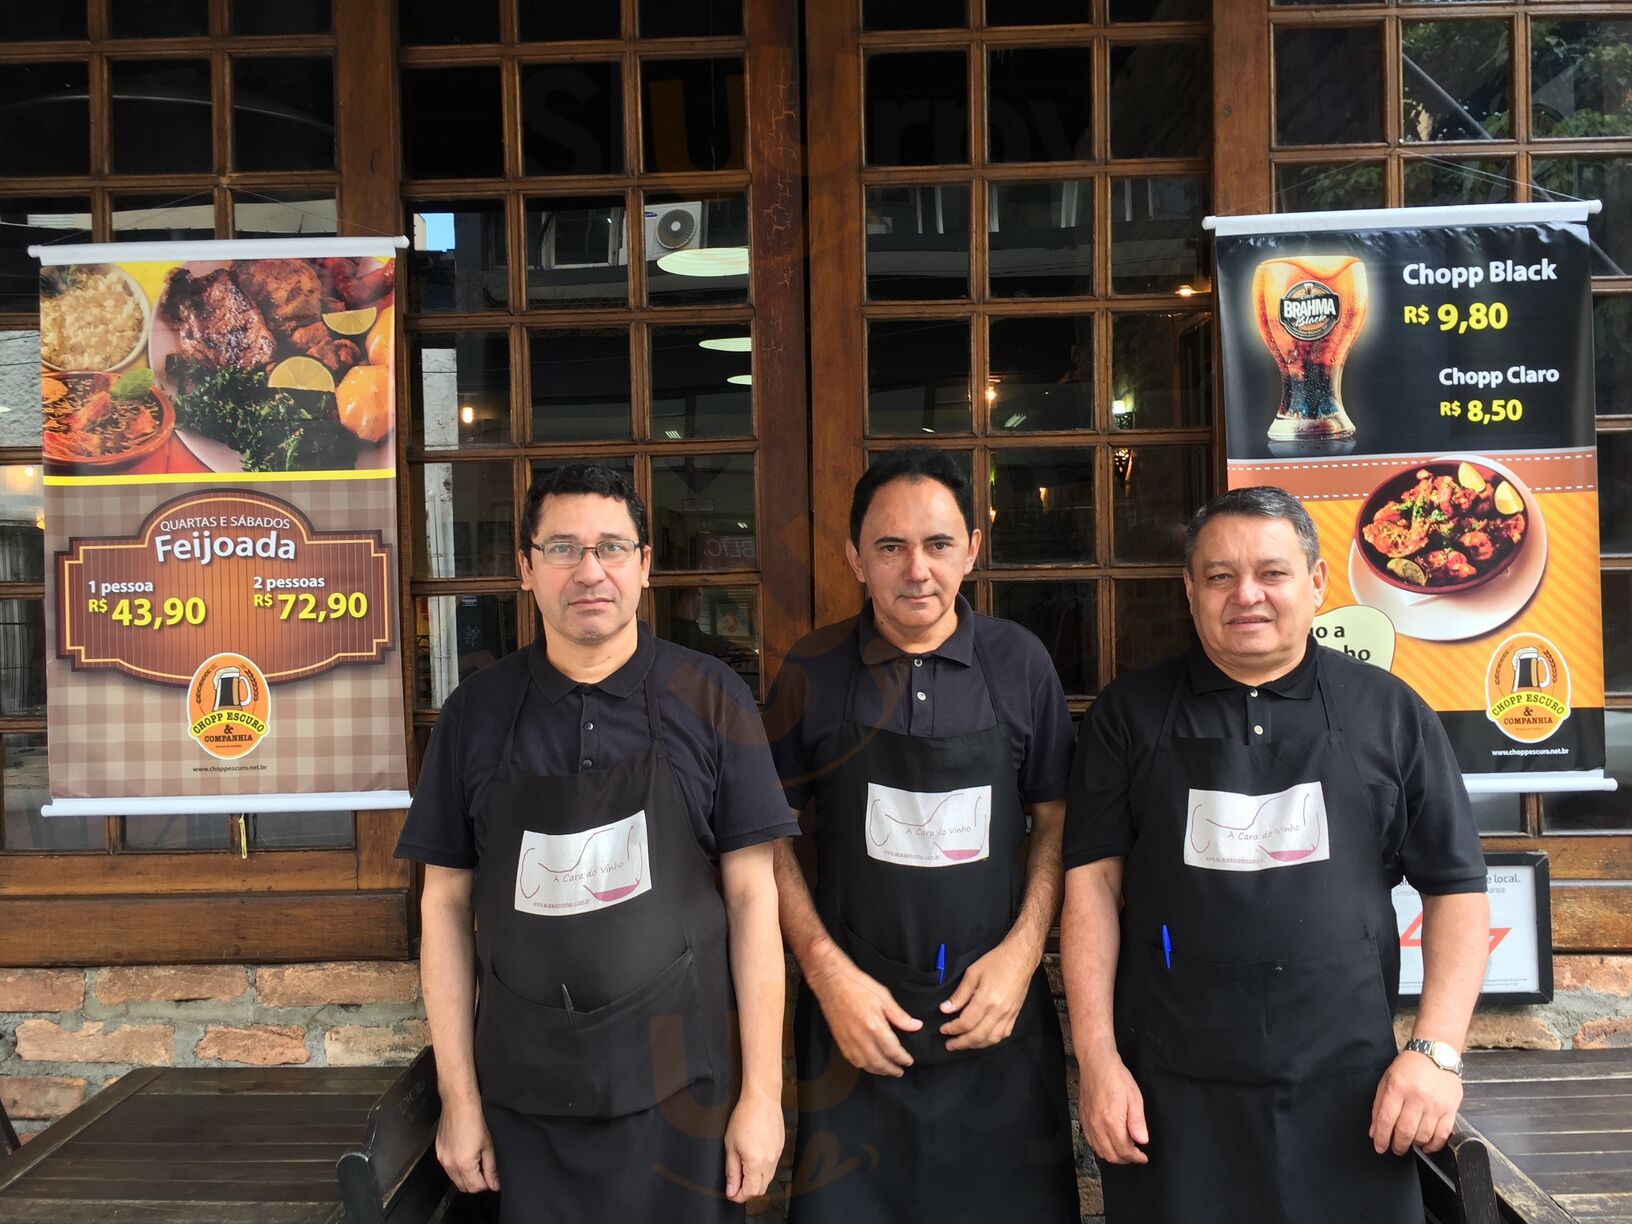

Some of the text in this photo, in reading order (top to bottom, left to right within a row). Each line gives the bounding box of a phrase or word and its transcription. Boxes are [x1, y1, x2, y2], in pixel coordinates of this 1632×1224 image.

[1402, 257, 1558, 289] Chopp Black
[1283, 298, 1337, 319] BRAHMA
[1404, 302, 1509, 334] R$ 9,80
[1438, 365, 1560, 388] Chopp Claro
[1440, 398, 1523, 425] R$ 8,50
[160, 514, 290, 531] QUARTAS E SÁBADOS
[154, 530, 296, 565] Feijoada
[88, 580, 154, 596] 1 pessoa
[253, 576, 325, 592] 2 pessoas
[88, 596, 206, 630] R$ 43,90
[253, 591, 368, 623] R$ 72,90
[1333, 625, 1345, 638] a
[1492, 693, 1564, 716] CHOPP ESCURO
[1523, 706, 1533, 717] &
[193, 712, 265, 734] CHOPP ESCURO
[1503, 716, 1553, 725] COMPANHIA
[223, 723, 234, 735] &
[204, 734, 253, 743] COMPANHIA
[1491, 747, 1569, 757] www.choppescuro.net.br
[192, 765, 267, 773] www.choppescuro.net.br
[915, 828, 935, 837] Cara
[1227, 824, 1300, 840] A Cara do Vinho
[553, 860, 624, 884] A Cara do Vinho
[1494, 873, 1521, 884] local.
[1394, 888, 1418, 897] Smok
